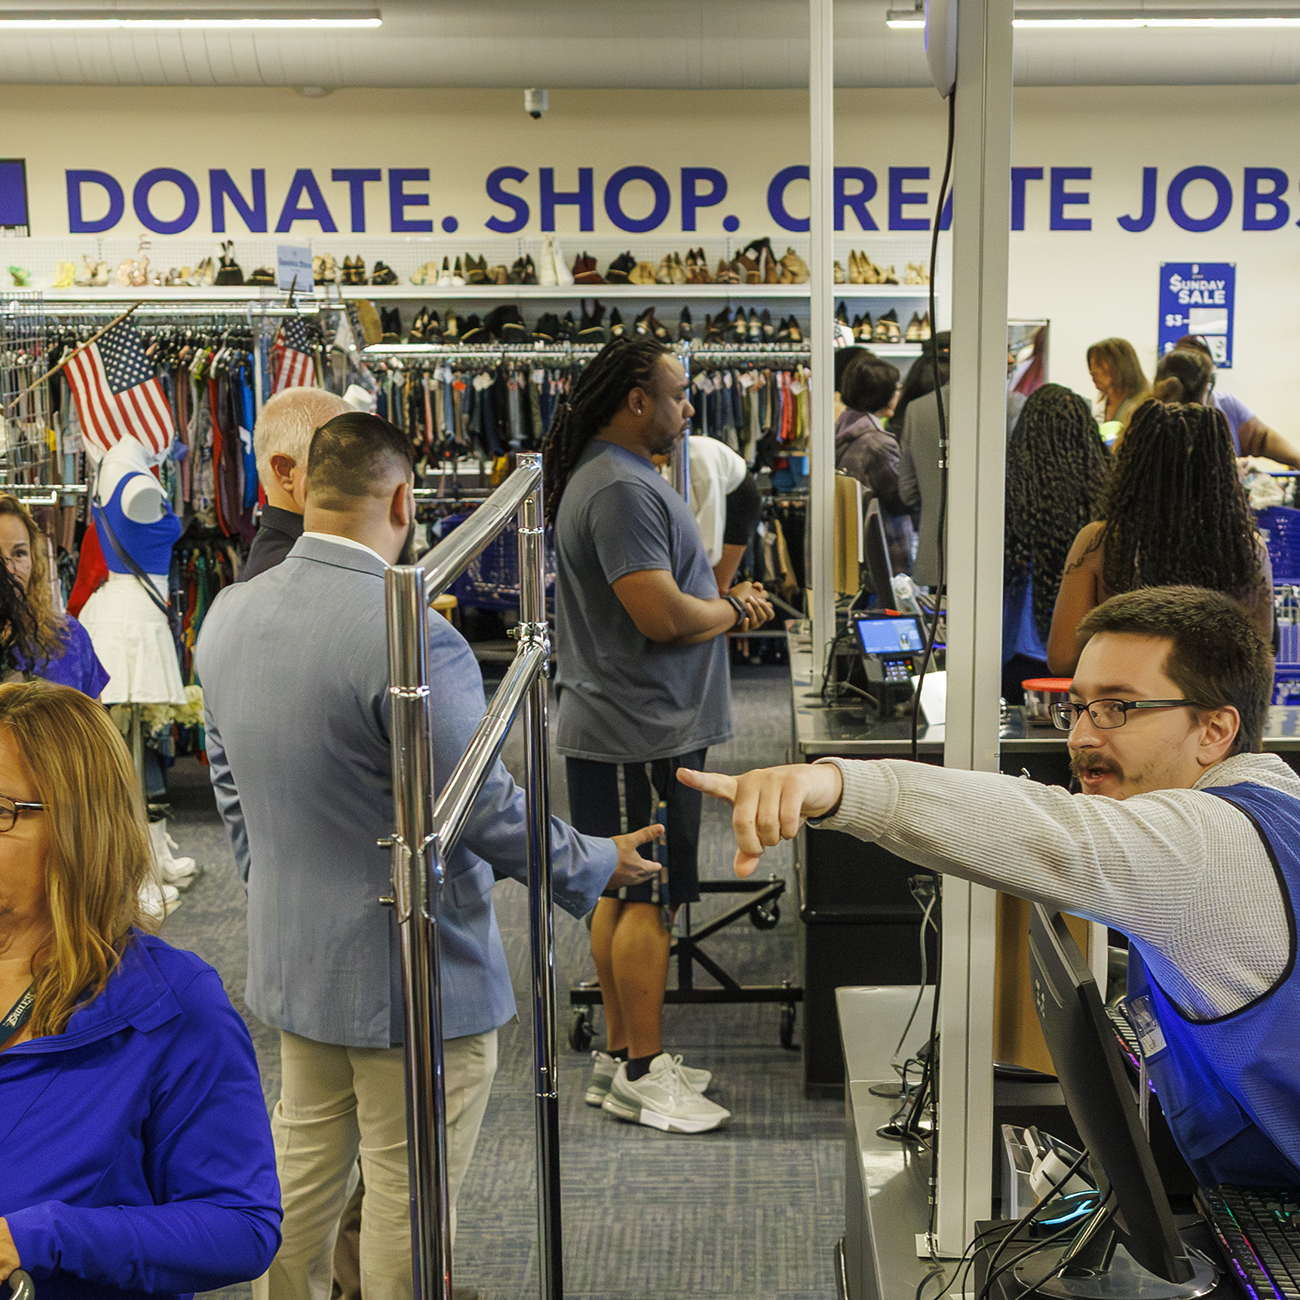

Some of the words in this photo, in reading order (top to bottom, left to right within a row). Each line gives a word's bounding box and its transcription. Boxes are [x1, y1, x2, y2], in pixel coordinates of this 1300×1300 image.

[65, 167, 459, 235] DONATE.
[485, 165, 740, 233] SHOP.
[767, 165, 1092, 233] CRETE
[1178, 289, 1226, 305] SALE
